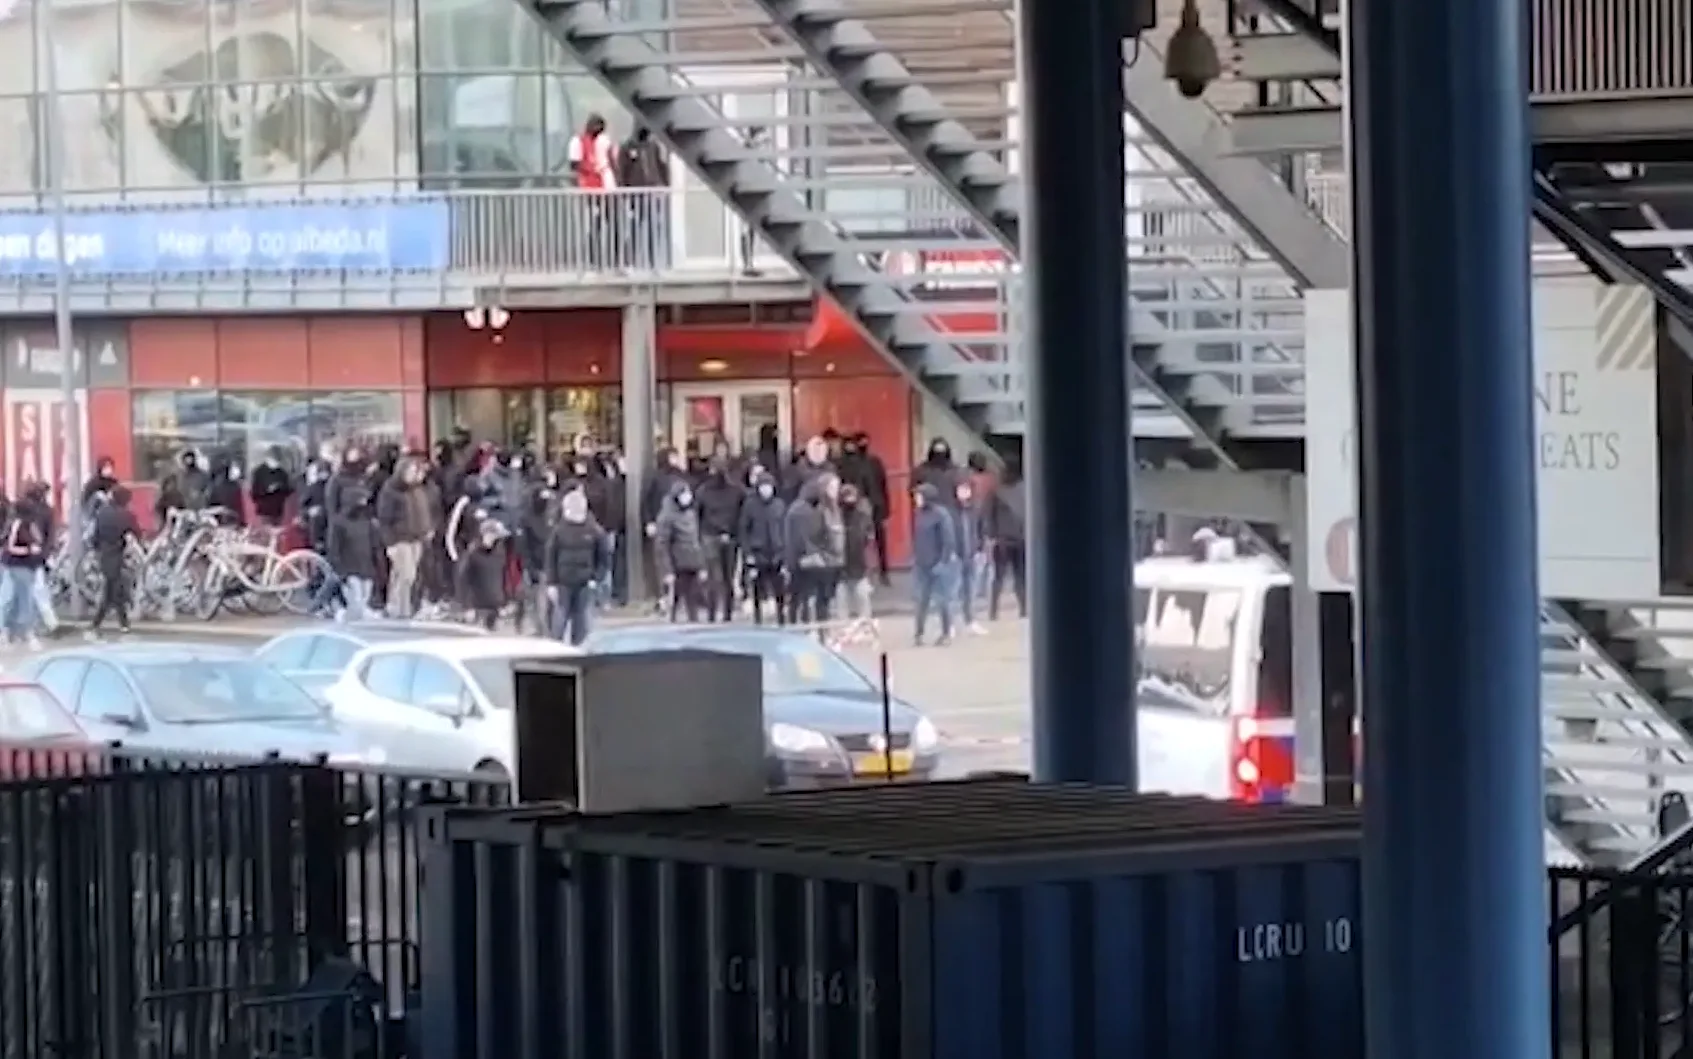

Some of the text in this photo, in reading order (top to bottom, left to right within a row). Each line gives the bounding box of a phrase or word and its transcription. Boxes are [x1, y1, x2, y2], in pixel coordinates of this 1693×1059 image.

[259, 231, 285, 258] op
[1238, 917, 1352, 963] LCRU 10
